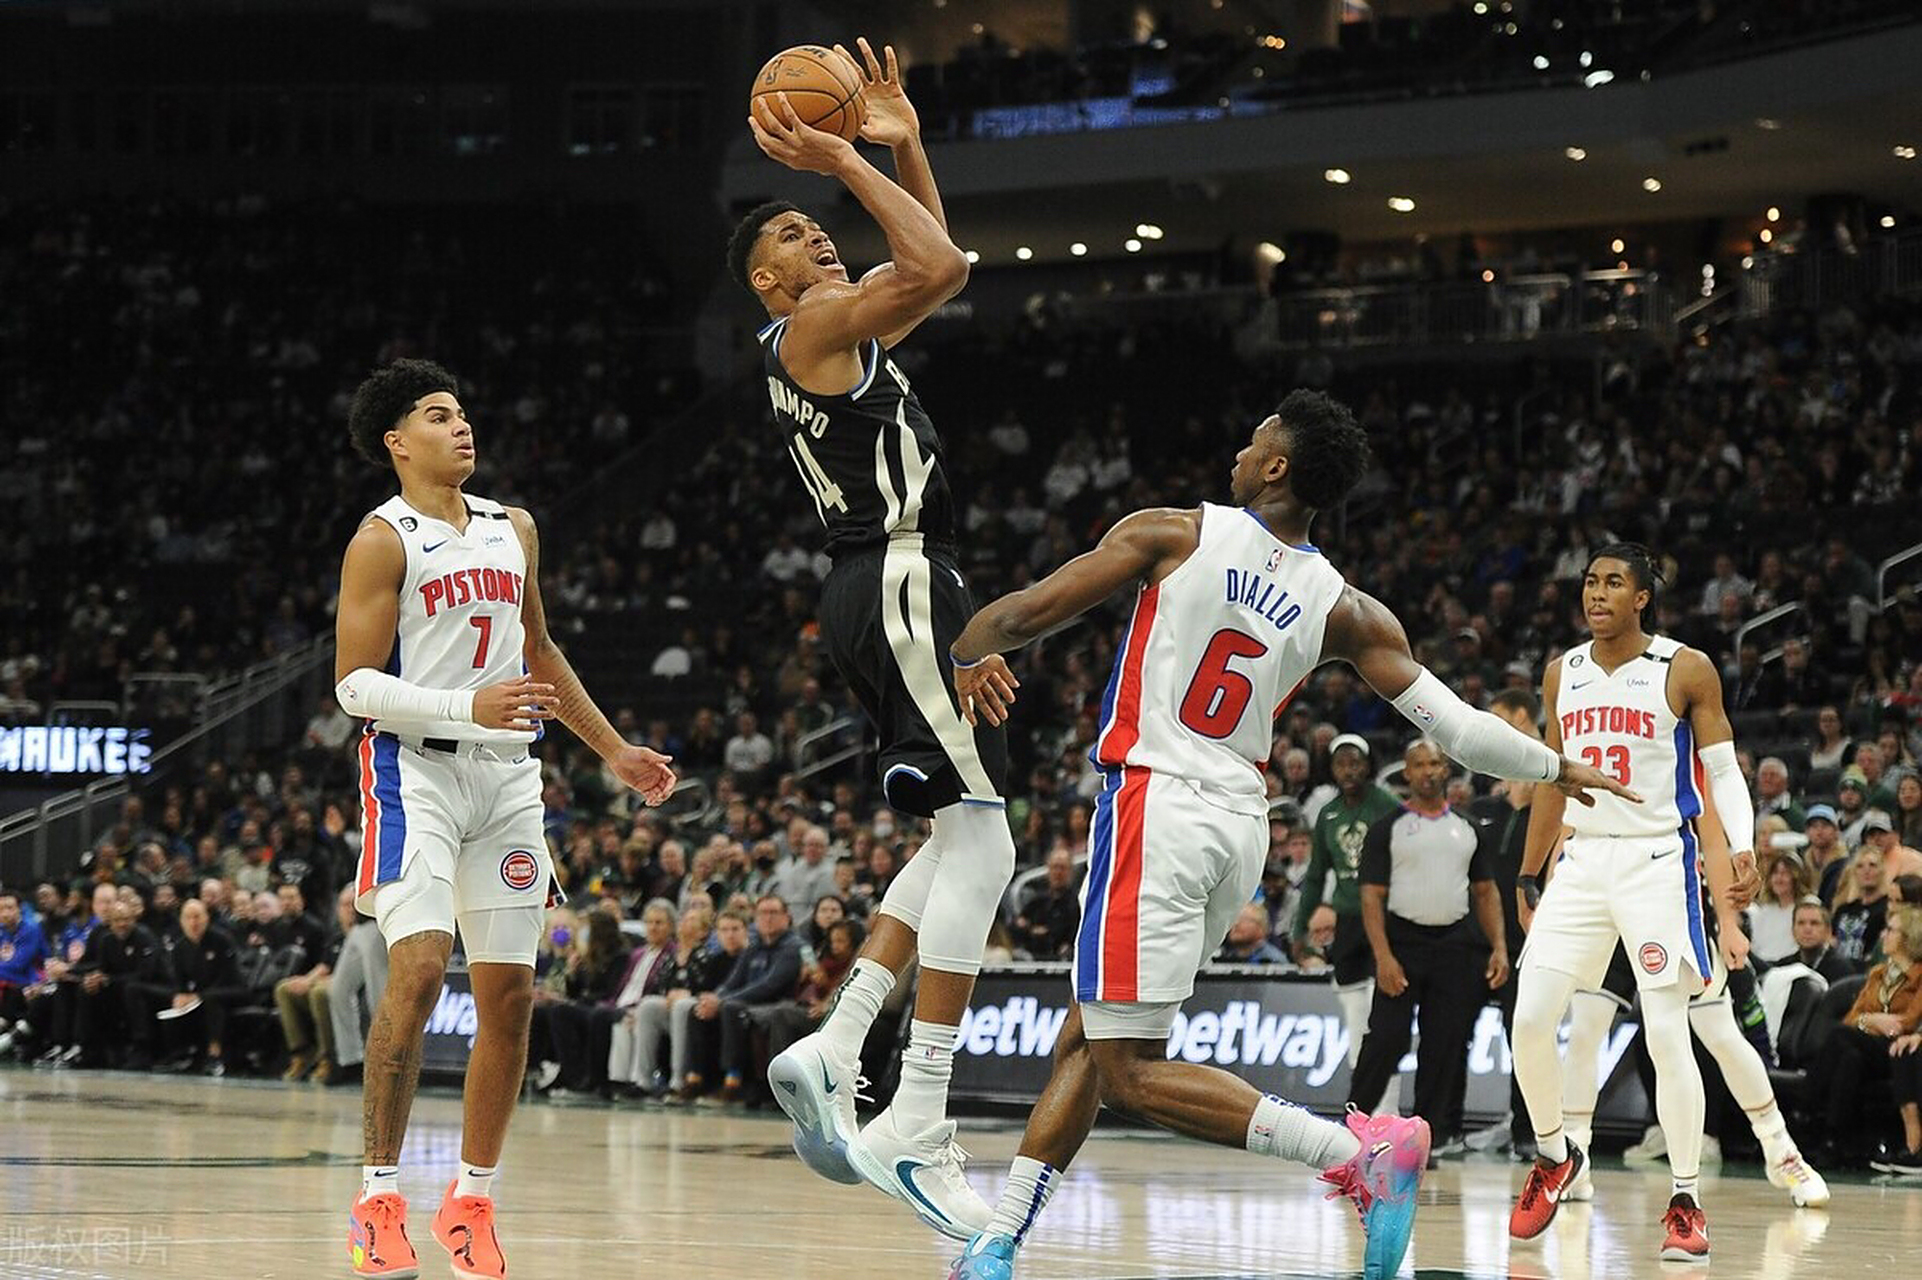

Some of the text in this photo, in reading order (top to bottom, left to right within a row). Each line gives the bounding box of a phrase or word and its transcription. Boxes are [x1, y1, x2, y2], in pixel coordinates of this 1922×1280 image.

[419, 568, 522, 617] PISTONS
[1227, 569, 1301, 630] DIALLO
[470, 616, 492, 669] 7
[1179, 628, 1269, 740] 6
[1562, 706, 1656, 740] PISTONS
